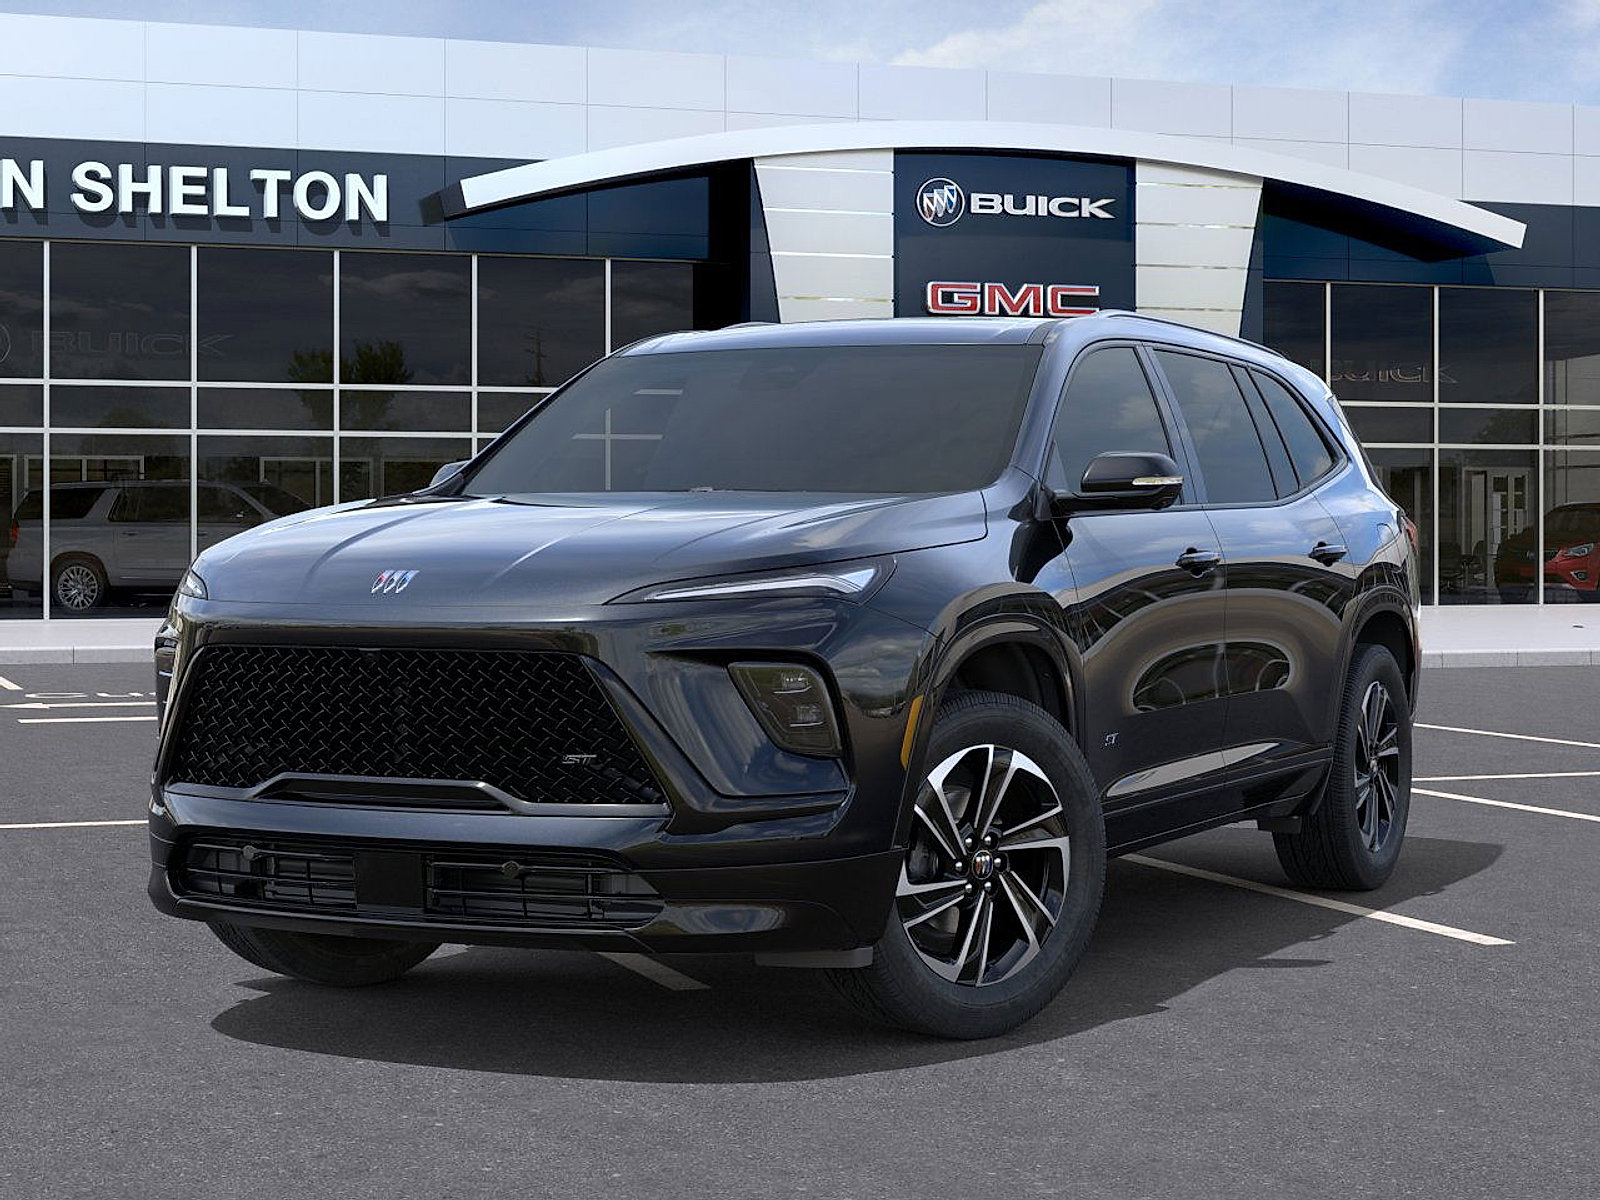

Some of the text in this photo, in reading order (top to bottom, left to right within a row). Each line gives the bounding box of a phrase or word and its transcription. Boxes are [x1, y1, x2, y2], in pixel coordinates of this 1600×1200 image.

[70, 160, 389, 223] SHELTON
[970, 192, 1117, 220] BUICK
[927, 280, 1101, 317] GMC
[31, 330, 234, 359] BUICK
